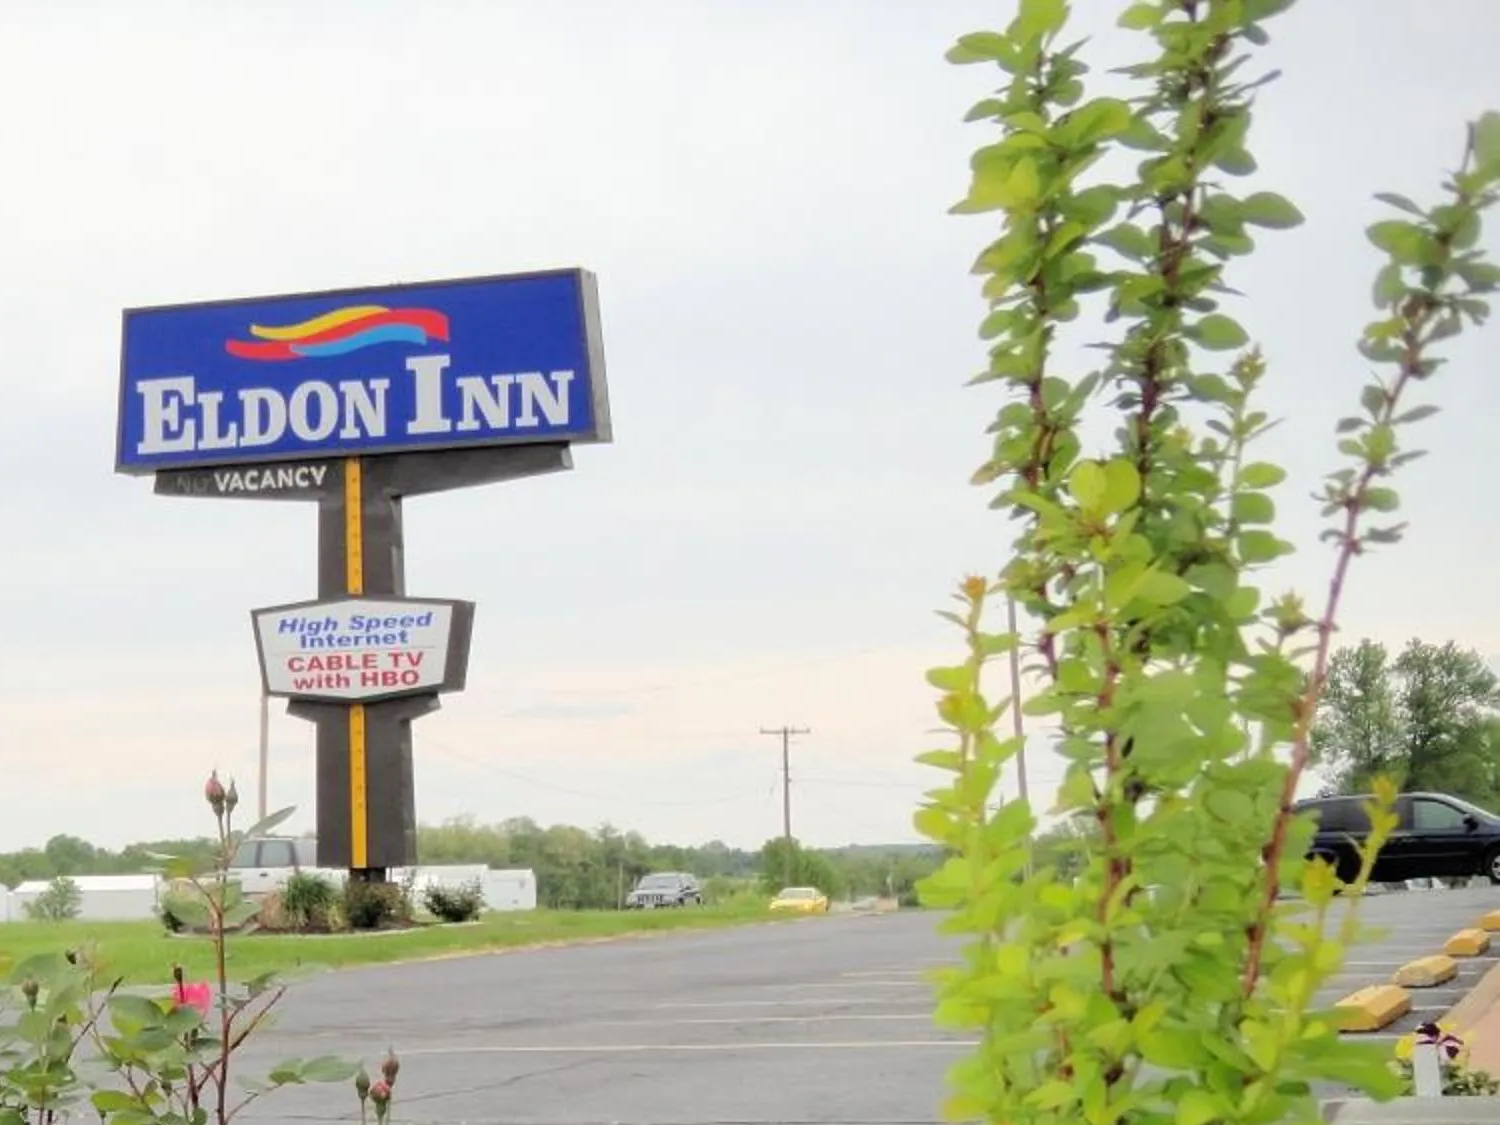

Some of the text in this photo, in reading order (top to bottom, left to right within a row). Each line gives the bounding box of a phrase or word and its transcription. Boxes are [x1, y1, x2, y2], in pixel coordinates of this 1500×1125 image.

[136, 354, 574, 455] ELDON INN
[213, 465, 327, 494] VACANCY
[278, 612, 433, 636] High Speed
[299, 631, 409, 649] Internet
[287, 651, 424, 672] CABLE TV
[293, 670, 419, 690] with HBO
